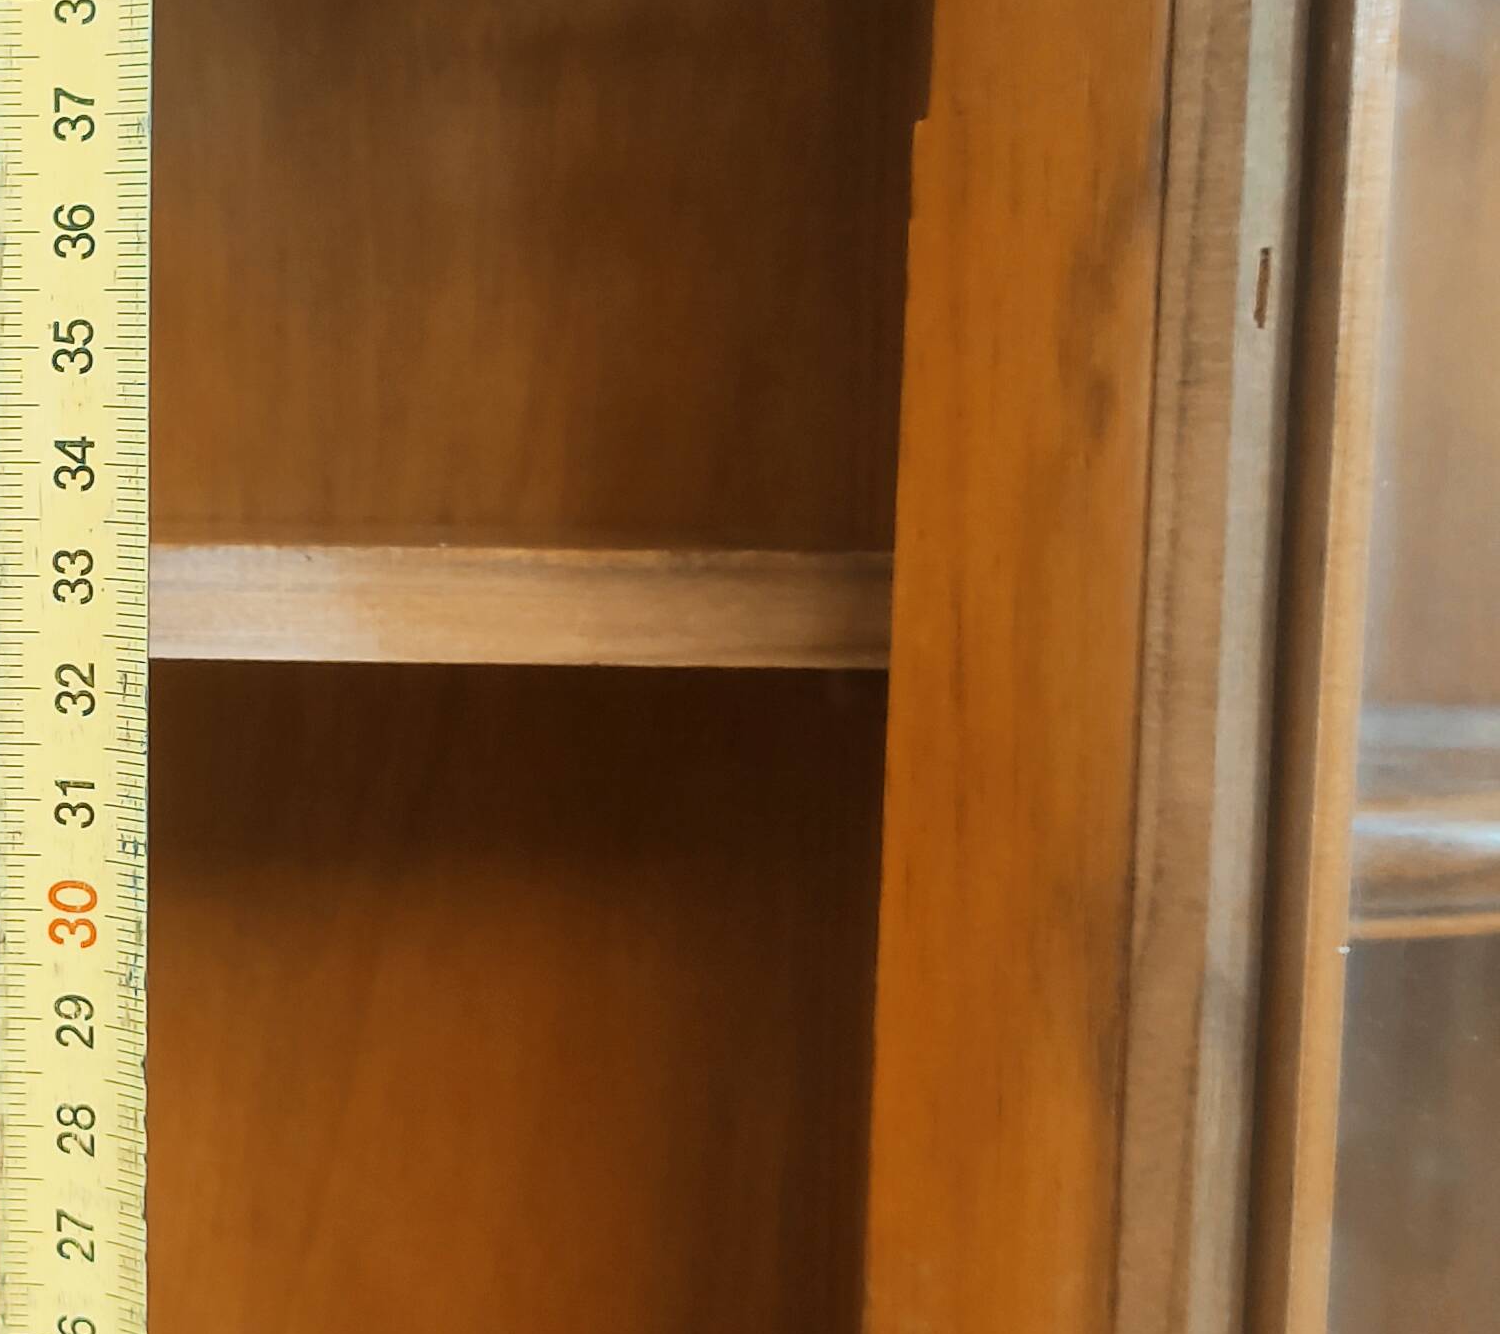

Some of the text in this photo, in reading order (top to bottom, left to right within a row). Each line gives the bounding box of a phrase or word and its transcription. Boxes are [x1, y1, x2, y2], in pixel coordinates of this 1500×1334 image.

[52, 87, 96, 142] 37
[52, 204, 96, 260] 36
[51, 318, 95, 375] 35
[52, 435, 96, 492] 34
[52, 549, 94, 605] 33
[54, 662, 96, 717] 32
[53, 780, 96, 829] 31
[47, 879, 98, 949] 30
[53, 994, 95, 1050] 29
[55, 1103, 97, 1158] 28
[55, 1209, 95, 1263] 27
